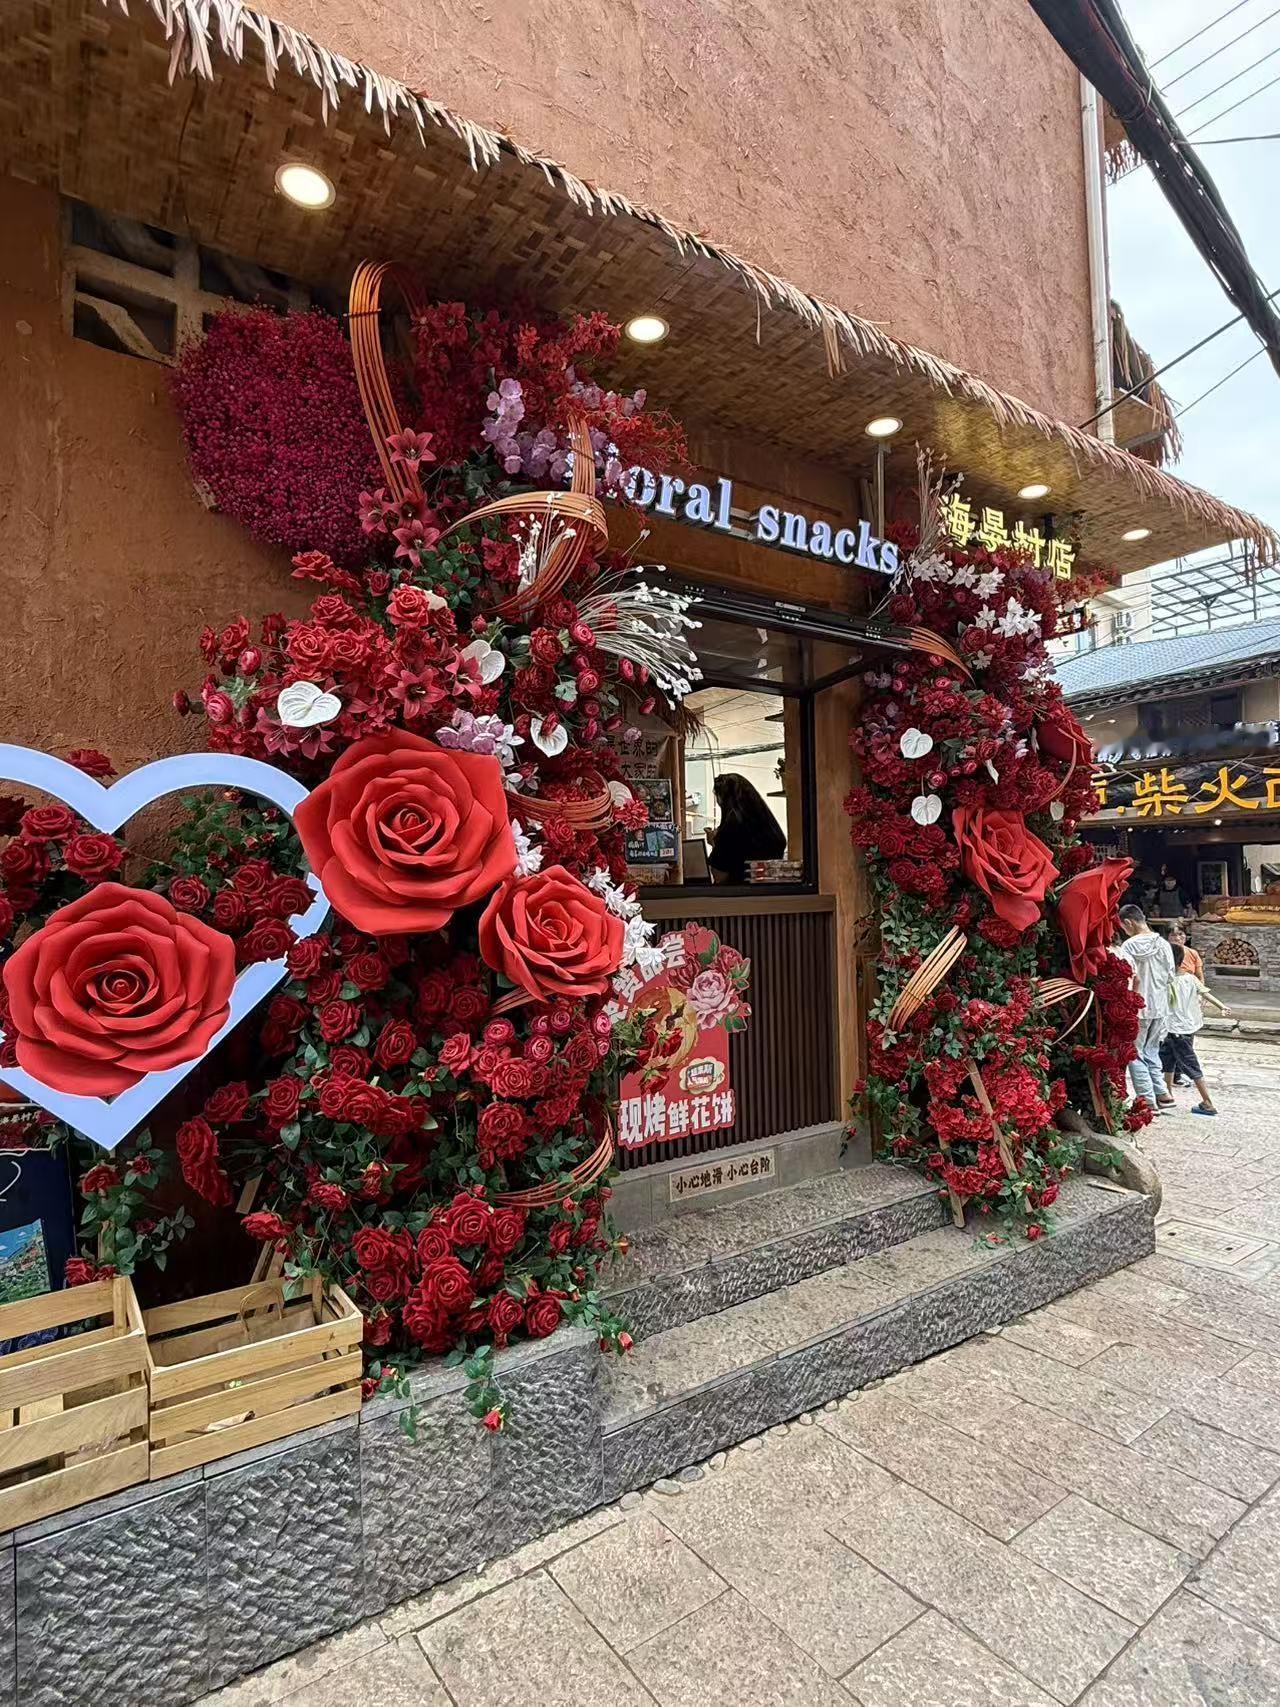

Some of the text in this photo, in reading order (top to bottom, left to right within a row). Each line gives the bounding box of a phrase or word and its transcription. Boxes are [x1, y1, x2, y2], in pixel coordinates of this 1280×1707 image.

[595, 442, 899, 575] oral snacks
[620, 1090, 733, 1145] 现烤鲜花饼
[676, 1156, 770, 1193] 小心地滑 小心台阶
